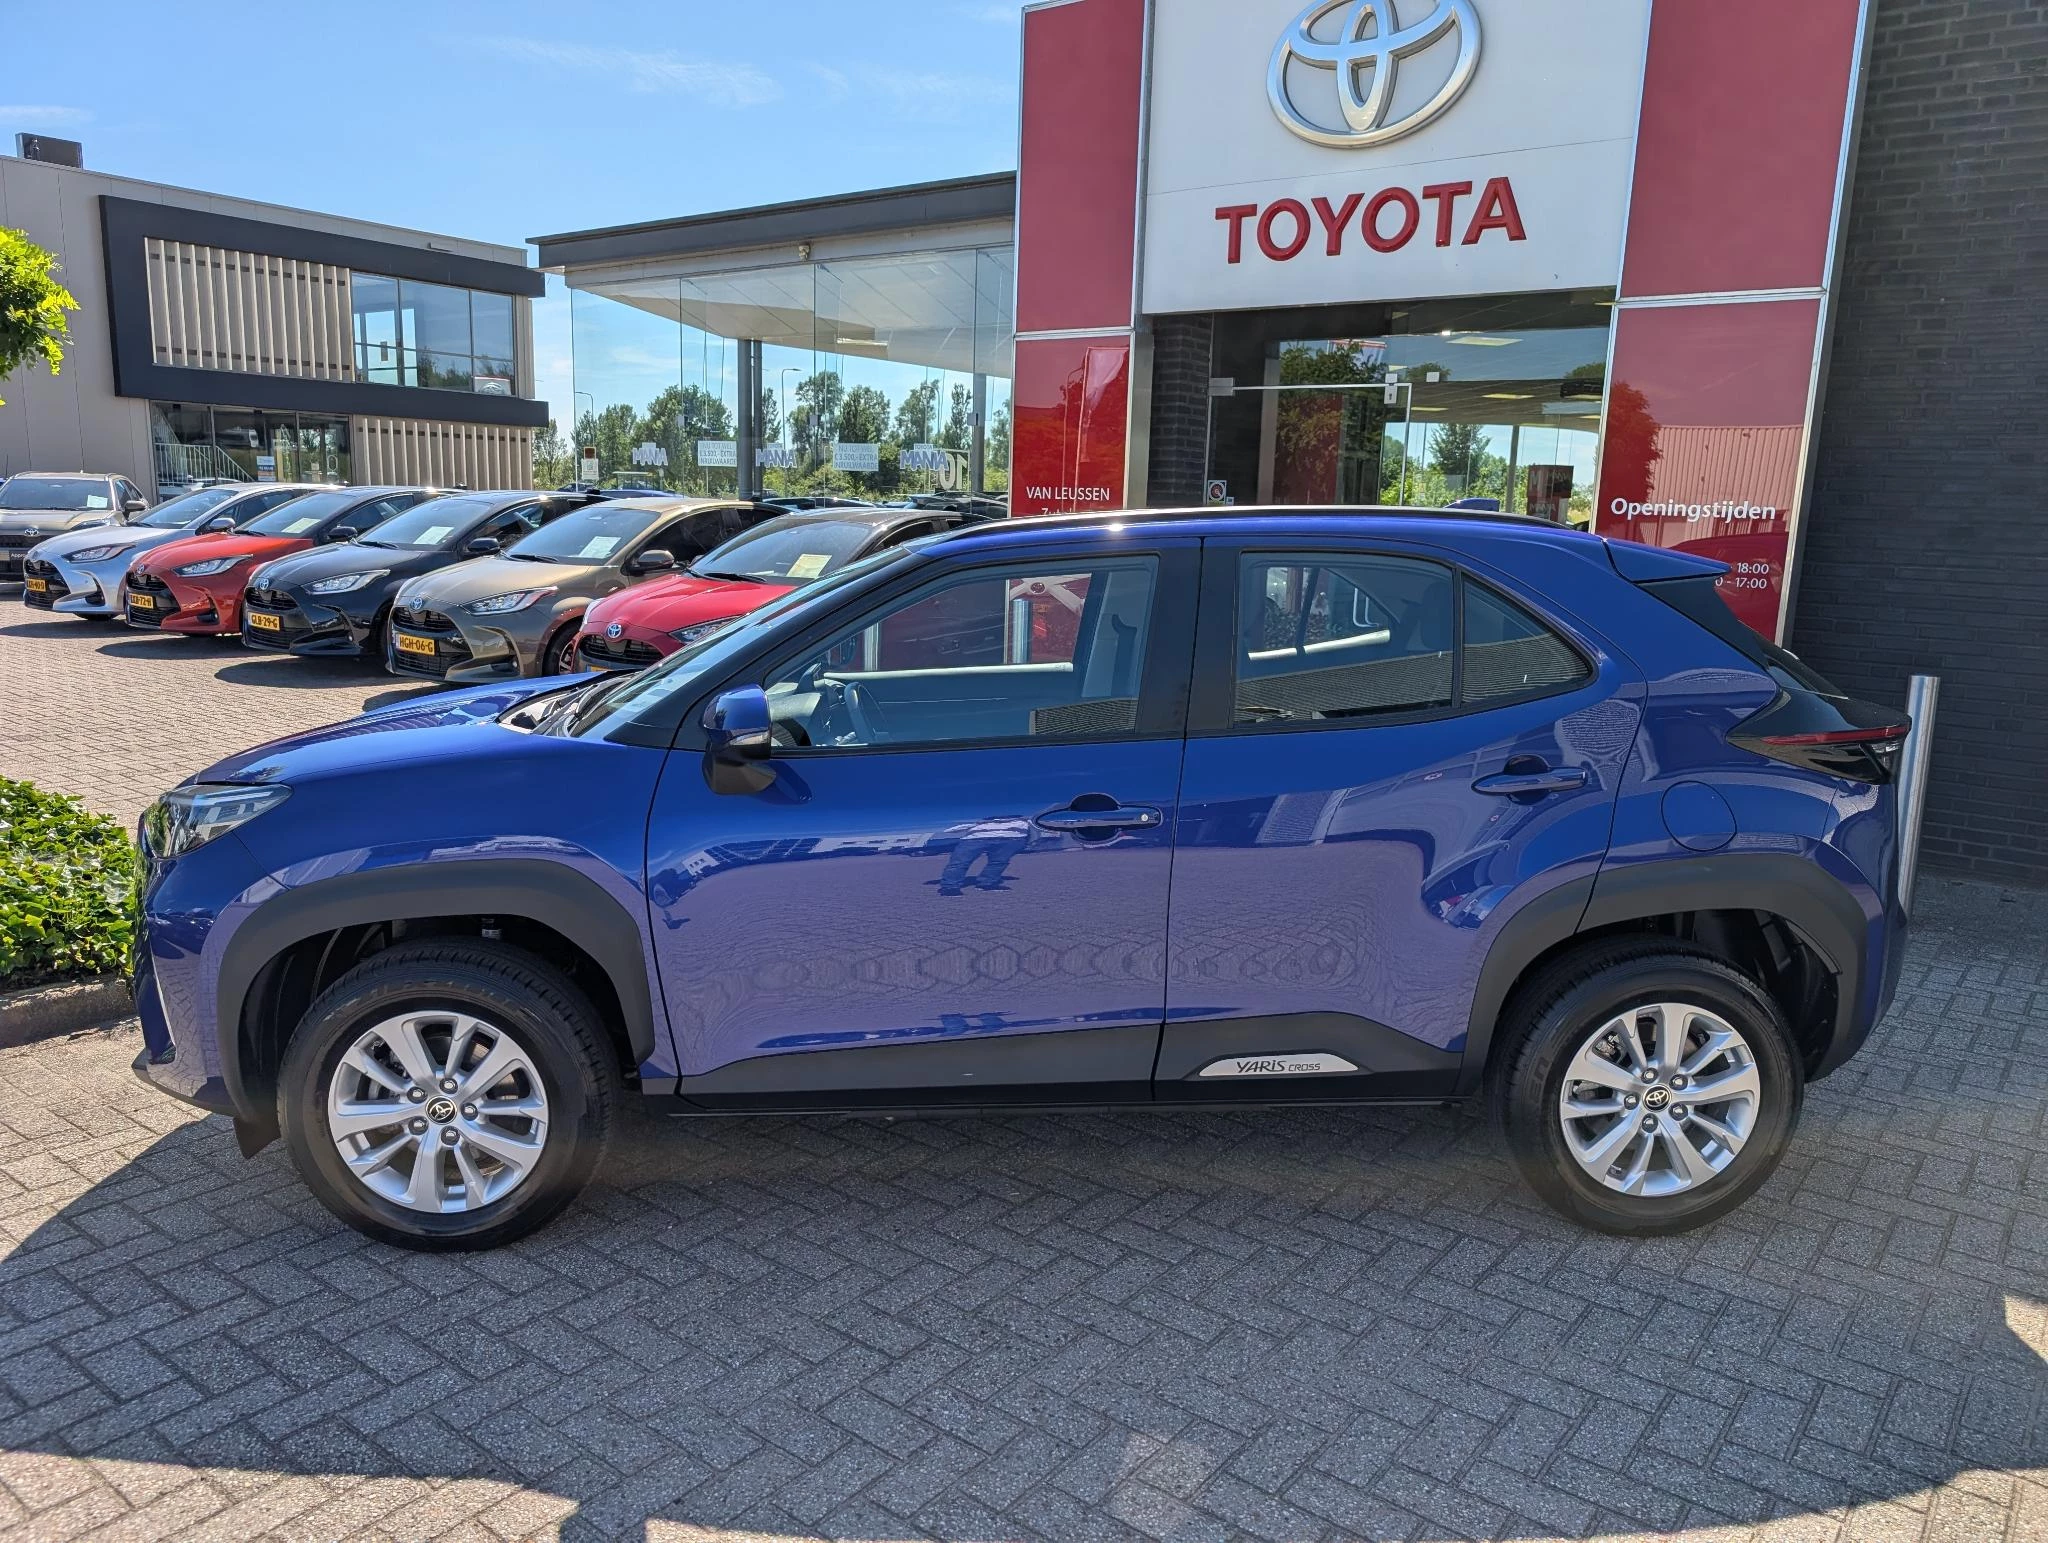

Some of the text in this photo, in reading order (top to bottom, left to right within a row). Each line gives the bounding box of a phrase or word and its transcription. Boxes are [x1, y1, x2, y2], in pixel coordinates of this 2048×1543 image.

[1215, 177, 1526, 264] TOYOTA
[755, 447, 797, 469] MANIA
[900, 449, 949, 471] MANIA
[1026, 486, 1110, 501] VAN LEUSSEN
[1611, 498, 1776, 523] Openingstijden
[1736, 562, 1769, 575] 18:00
[1735, 577, 1767, 589] 17:00
[399, 636, 434, 653] HGH-06-G
[1288, 1062, 1321, 1072] CROSS
